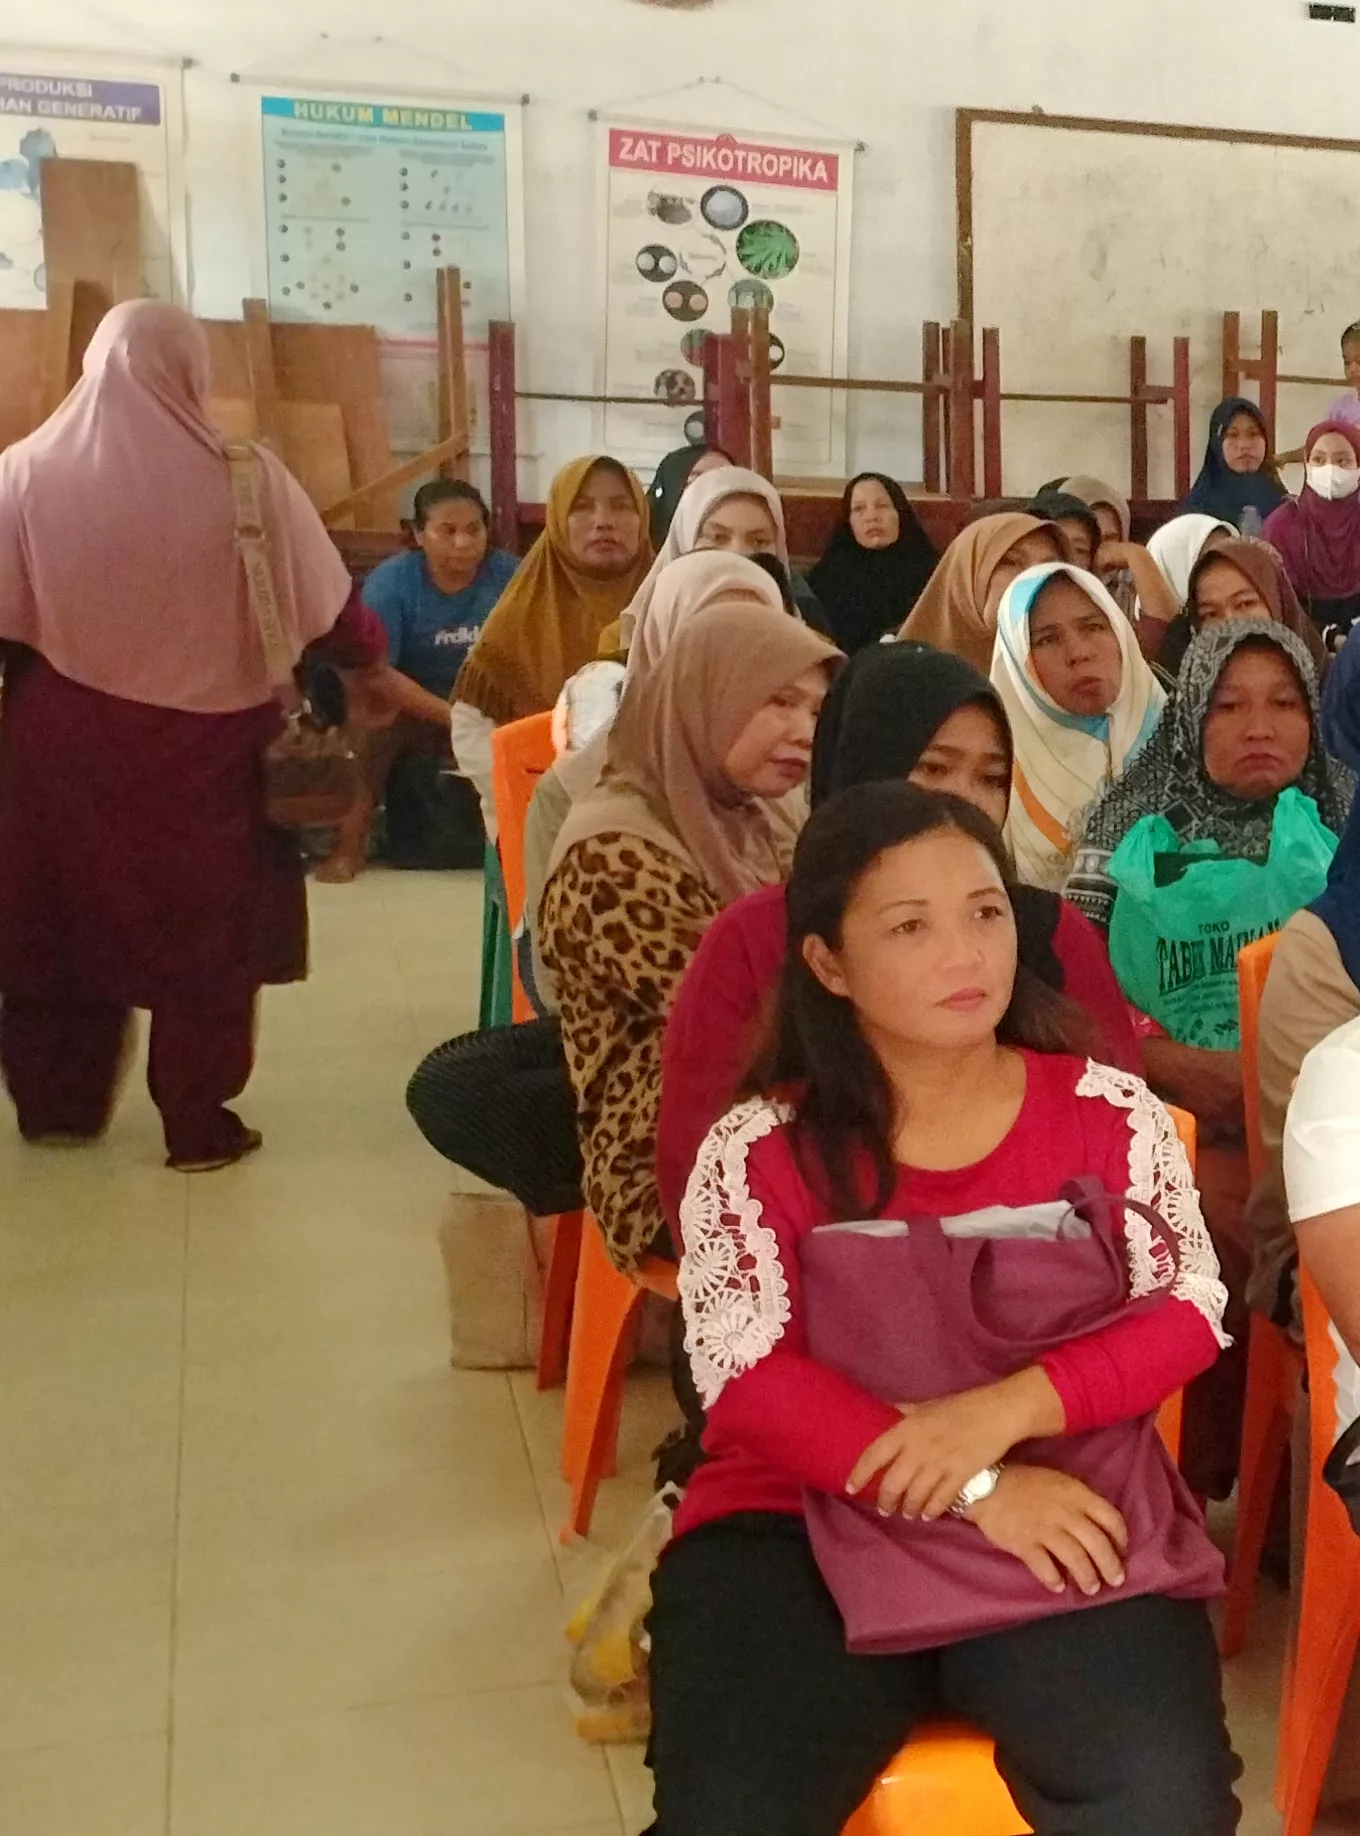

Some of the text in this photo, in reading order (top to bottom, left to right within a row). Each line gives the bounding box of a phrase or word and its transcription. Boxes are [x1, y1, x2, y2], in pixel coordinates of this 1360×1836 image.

[37, 100, 142, 121] GENERATIF
[293, 101, 473, 131] HUKUM MENDEL
[619, 137, 829, 183] ZAT PSIKOTROPIKA
[1198, 920, 1231, 935] TOKO
